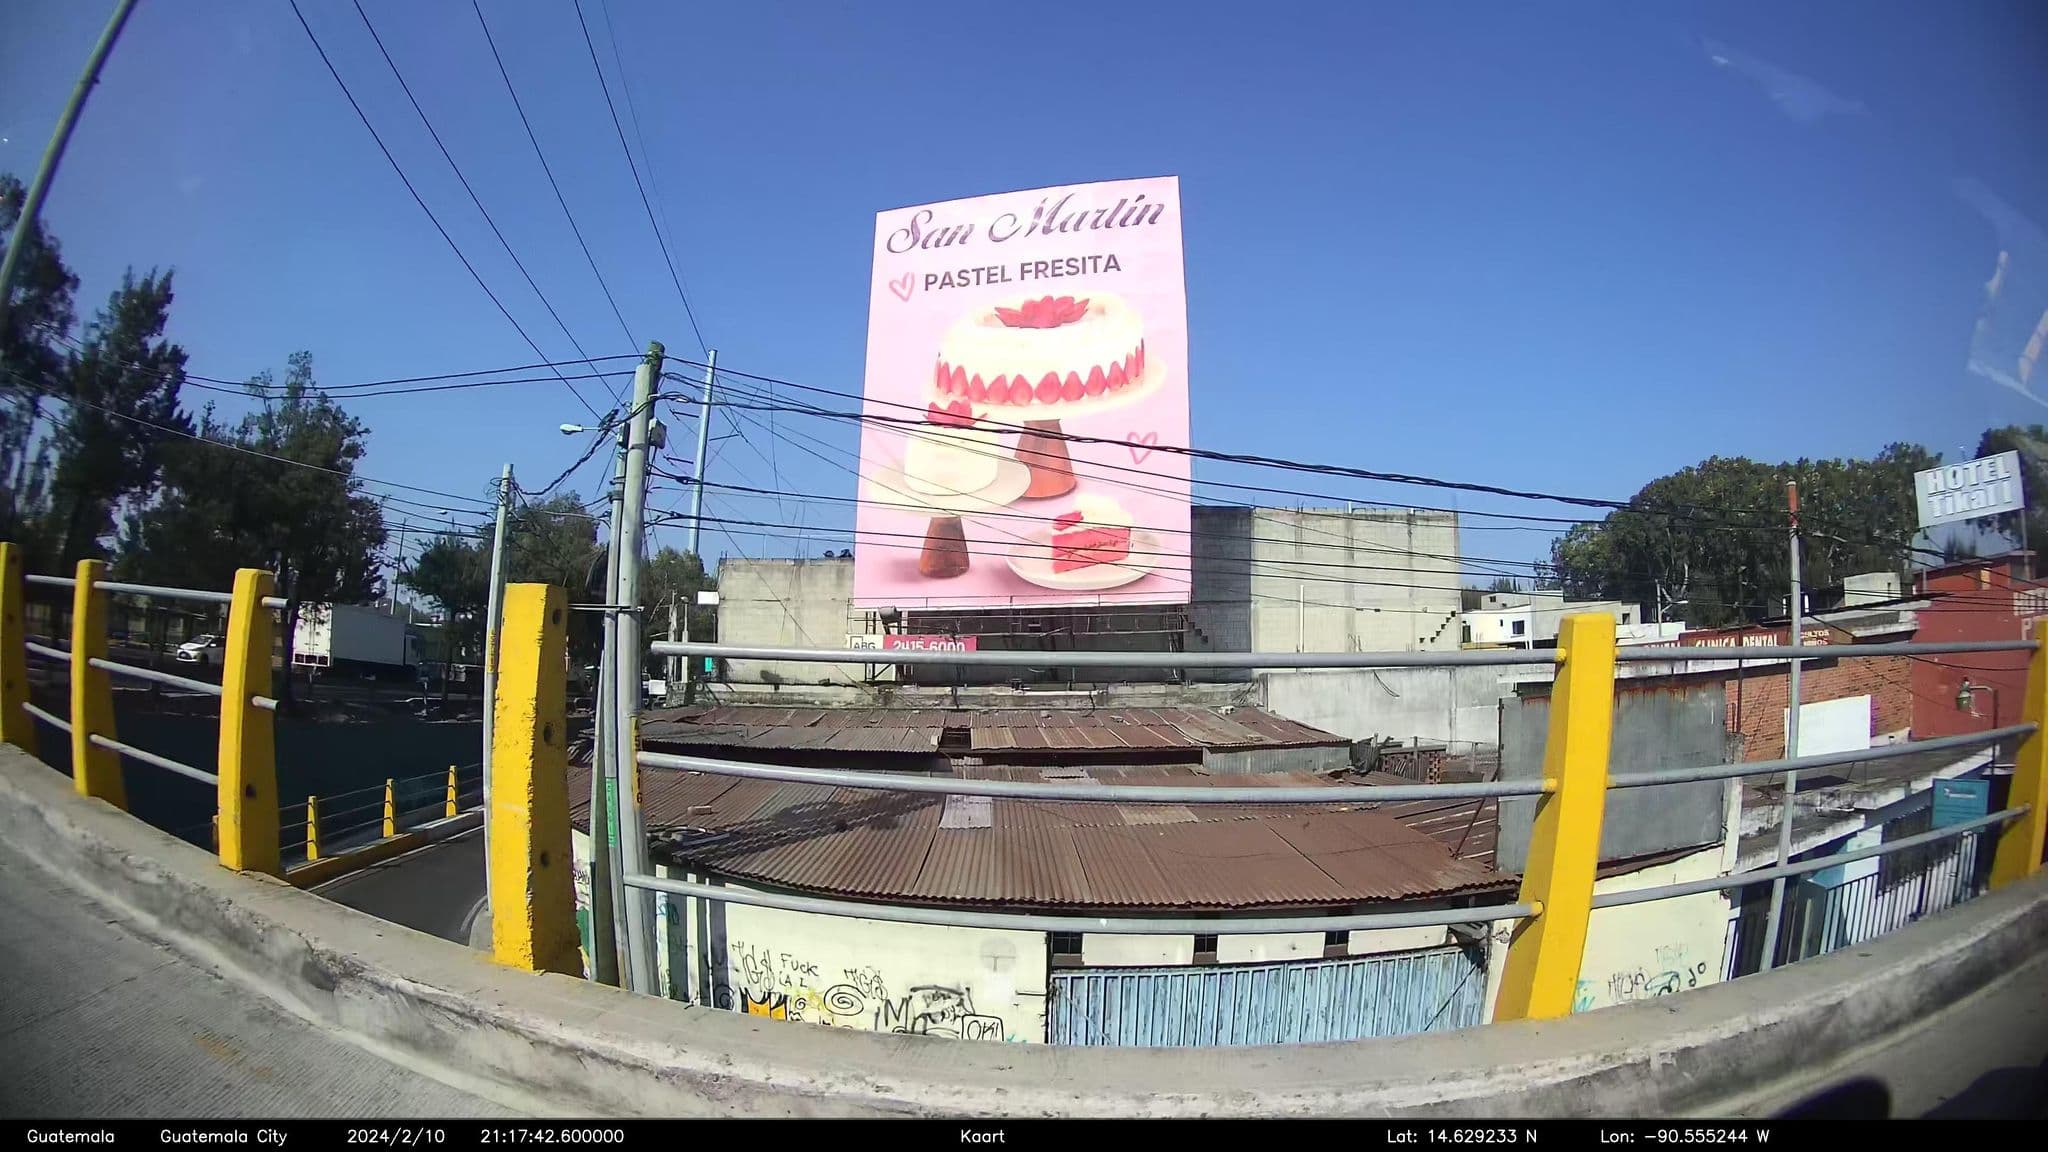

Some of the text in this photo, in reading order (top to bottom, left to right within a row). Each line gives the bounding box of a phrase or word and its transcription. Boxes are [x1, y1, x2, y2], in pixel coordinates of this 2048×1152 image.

[886, 209, 975, 254] San
[924, 253, 1122, 292] PASTEL FRESITA
[1927, 456, 2011, 495] HOTEL
